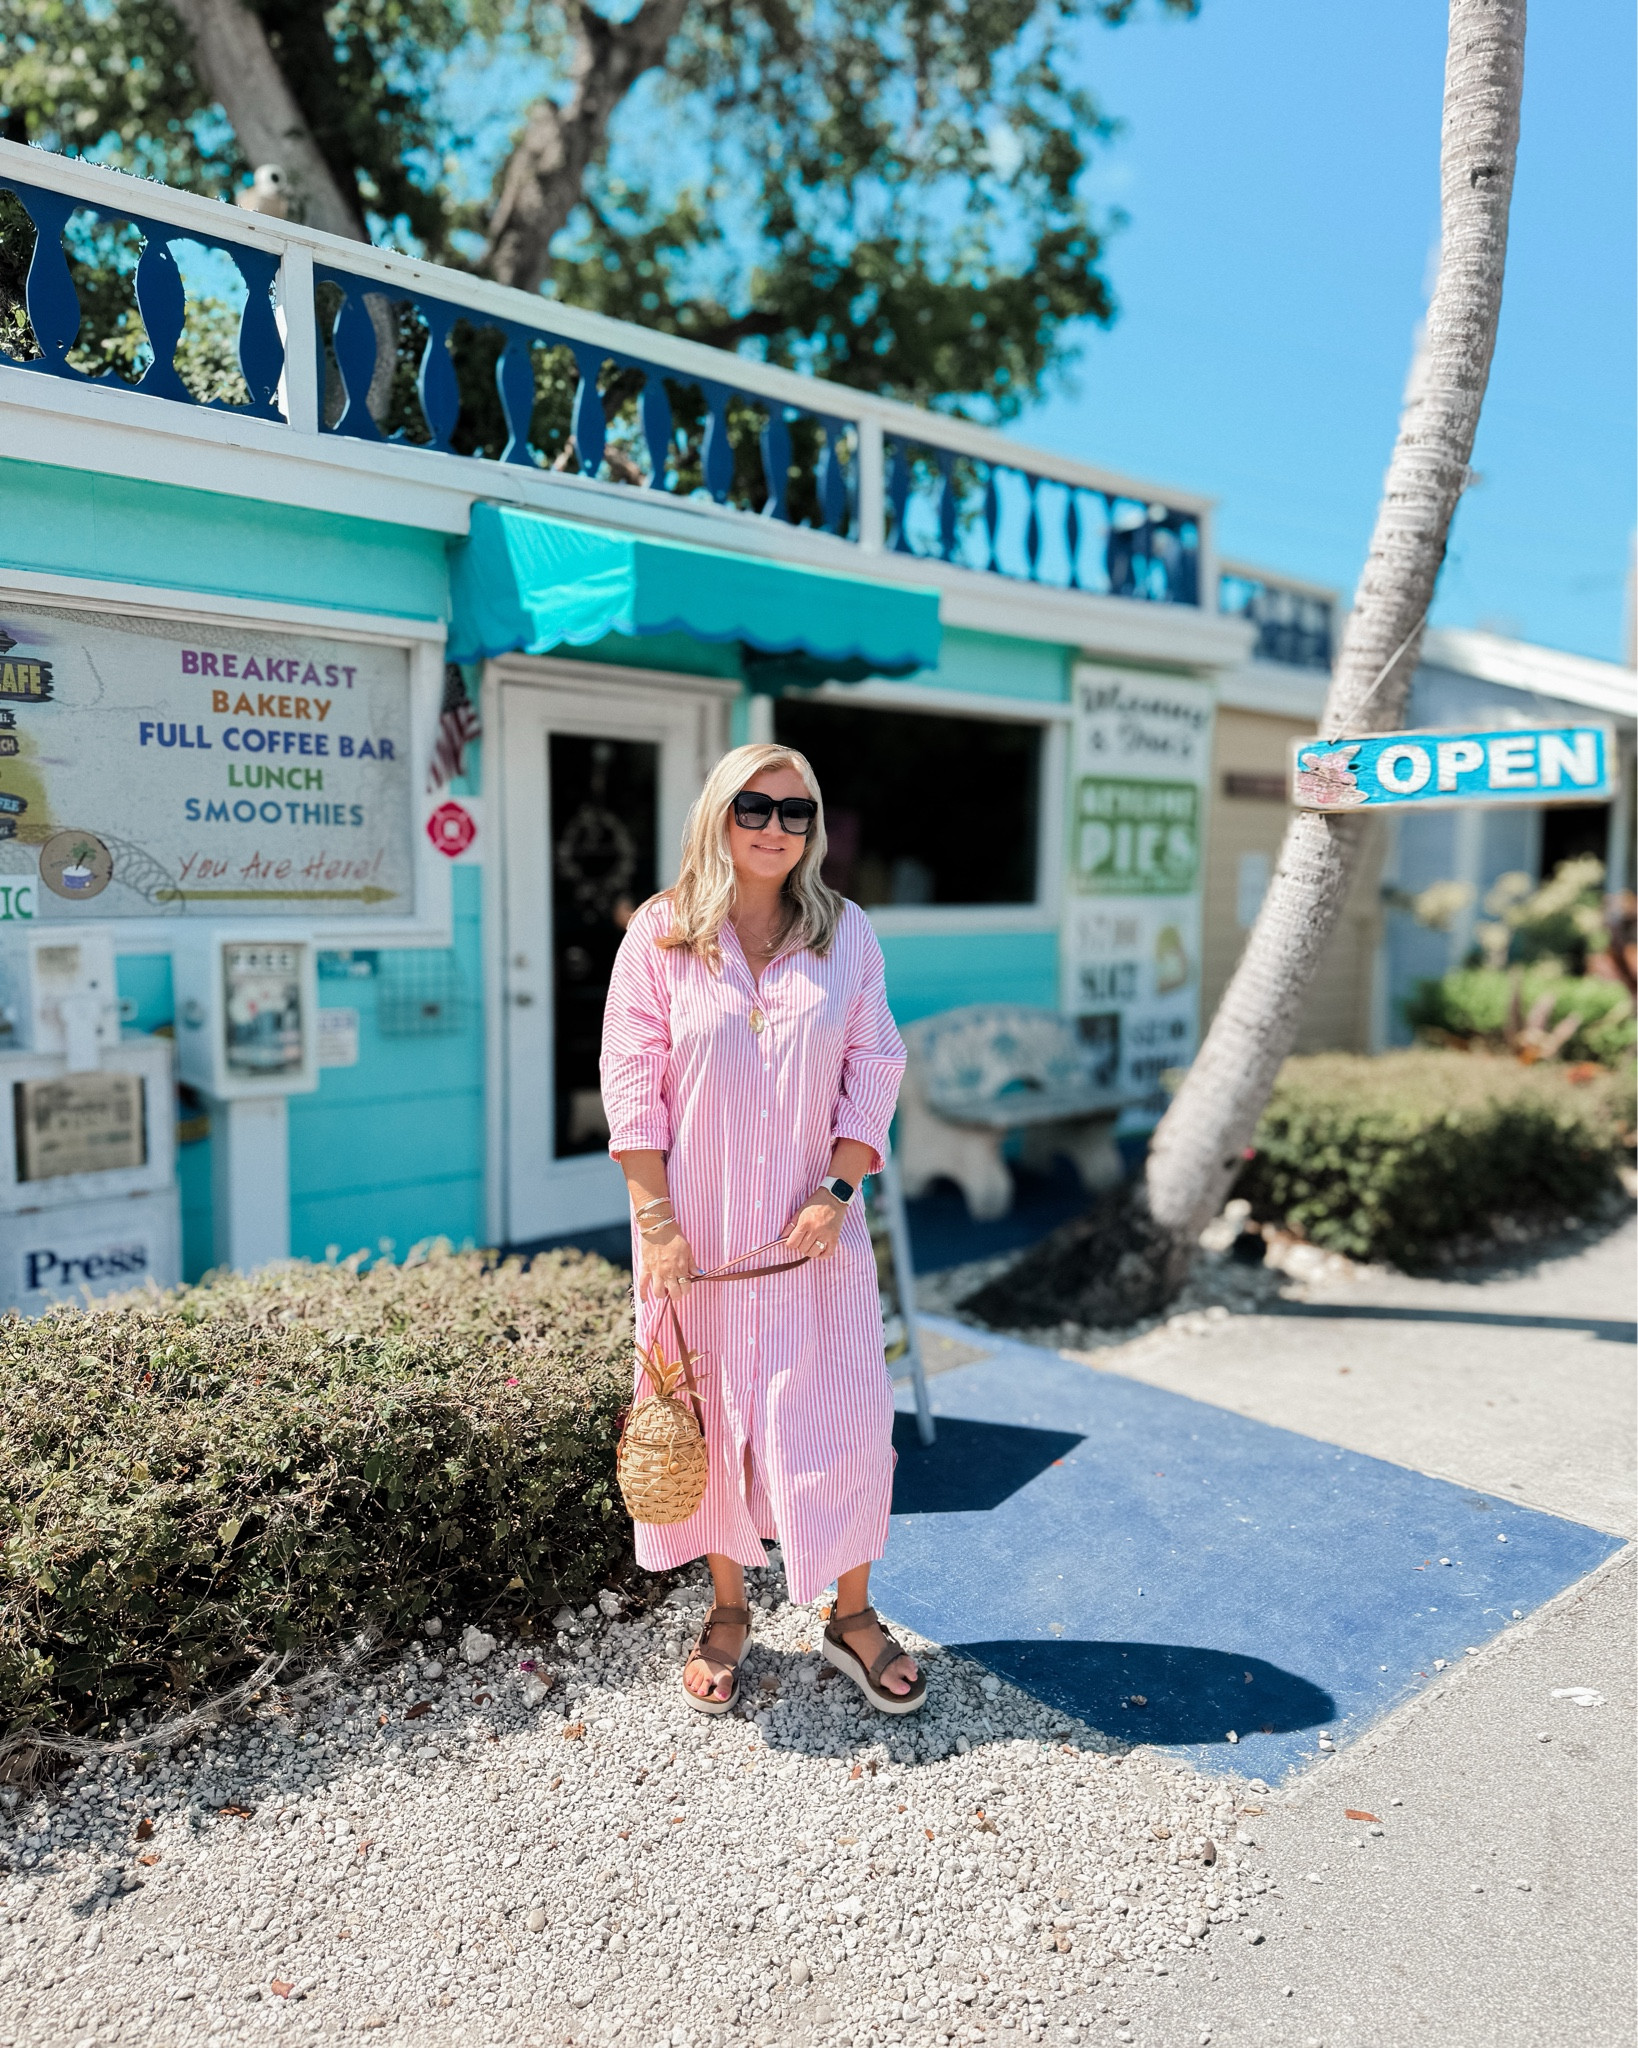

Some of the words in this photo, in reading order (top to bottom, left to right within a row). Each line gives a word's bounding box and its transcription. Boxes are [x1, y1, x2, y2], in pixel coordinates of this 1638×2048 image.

[0, 663, 41, 694] AFE
[181, 650, 357, 689] BREAKFAST
[212, 689, 332, 722] BAKERY
[140, 721, 212, 749] FULL
[222, 727, 329, 756] COFFEE
[339, 735, 396, 761] BAR
[228, 764, 323, 791] LUNCH
[1376, 731, 1599, 794] OPEN
[185, 798, 364, 826] SMOOTHIES
[178, 852, 229, 881] You
[240, 851, 292, 879] Are
[301, 849, 385, 882] Here!
[1080, 823, 1195, 873] PIES
[25, 1248, 148, 1289] Press
